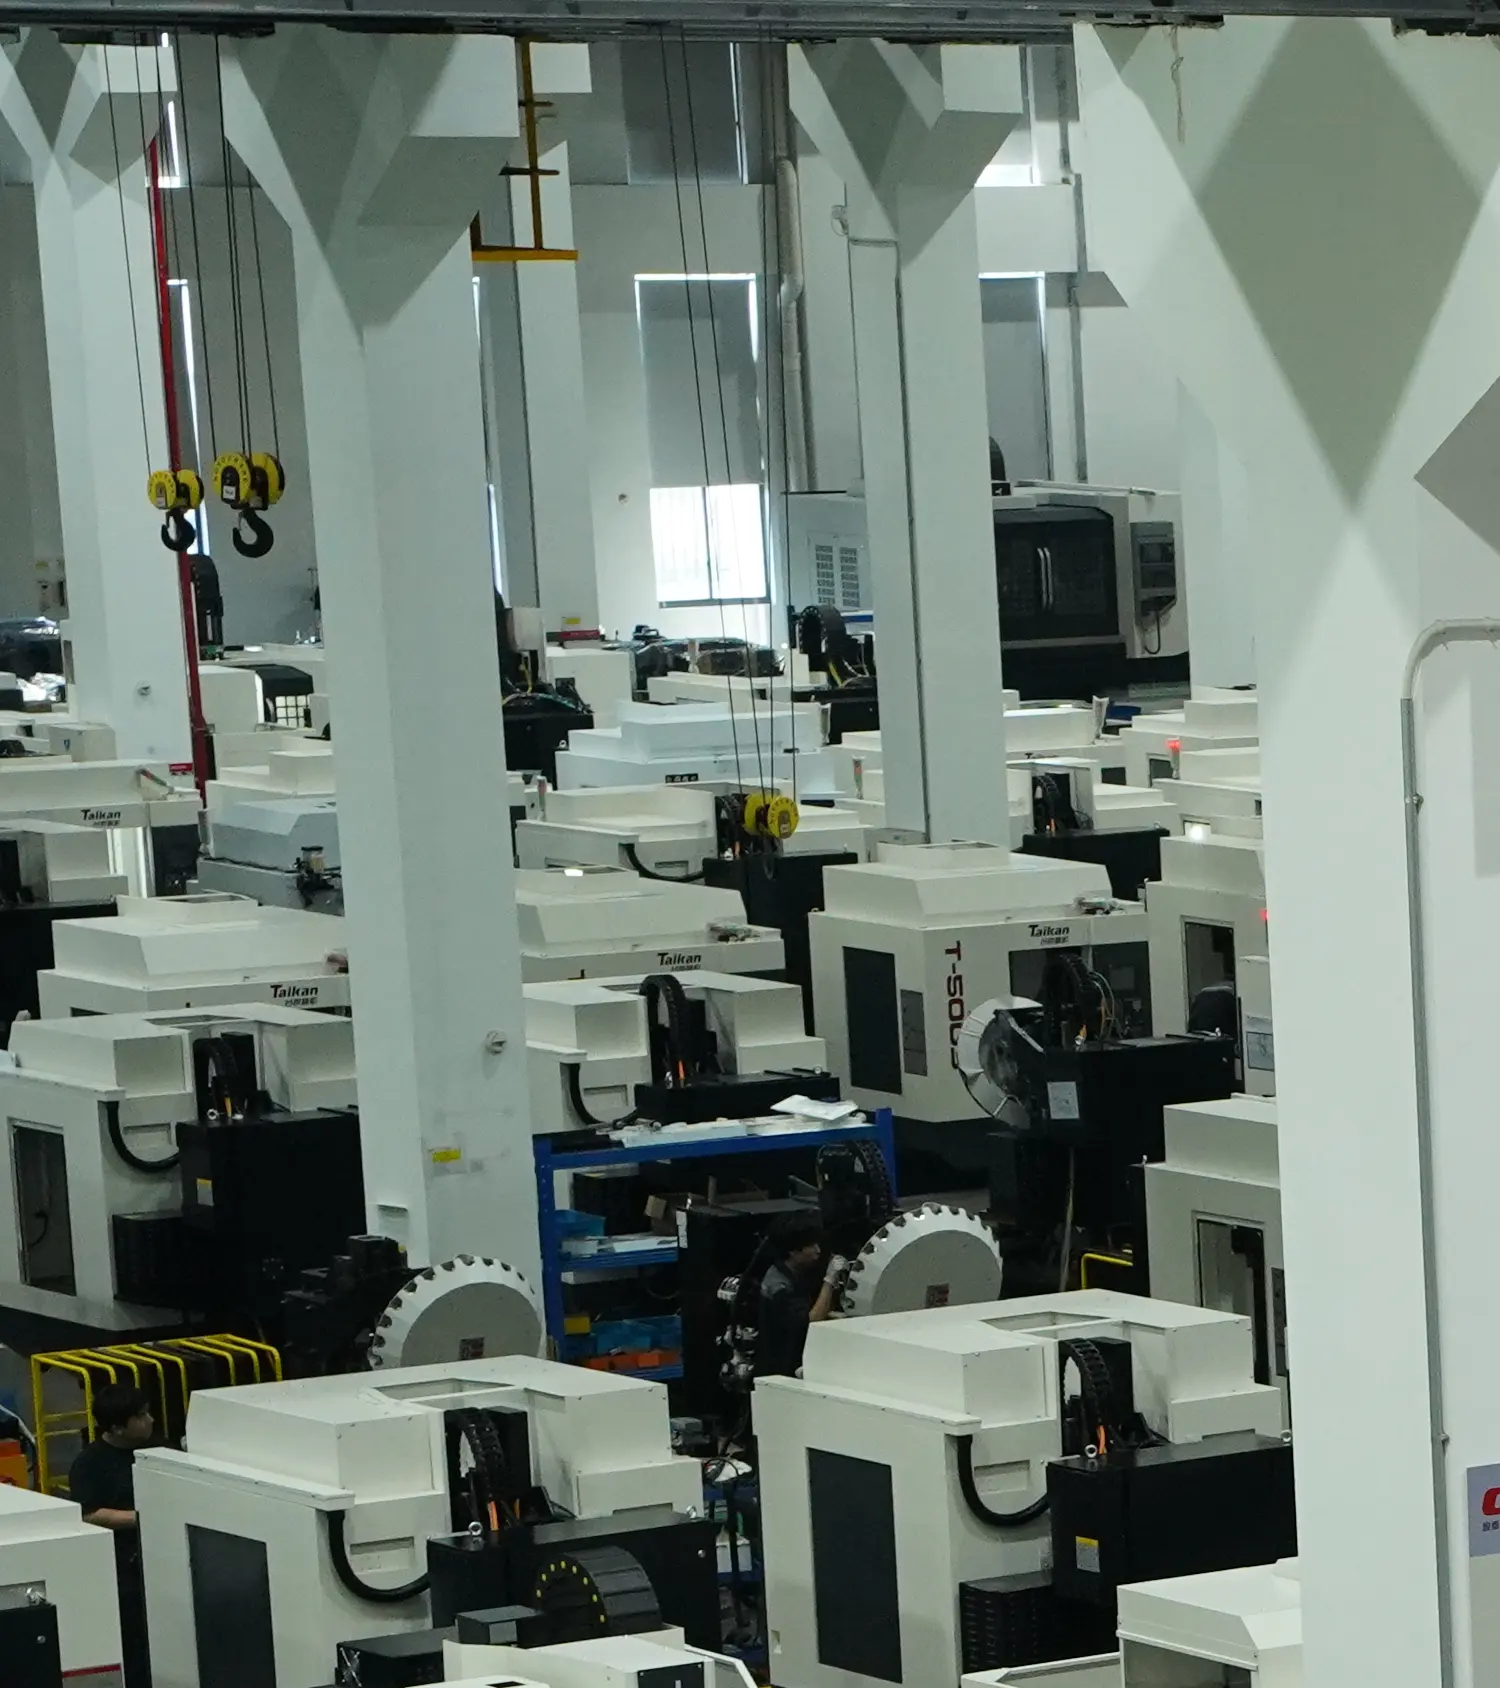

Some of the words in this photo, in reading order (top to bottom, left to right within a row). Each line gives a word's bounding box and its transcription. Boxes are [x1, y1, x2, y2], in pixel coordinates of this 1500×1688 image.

[1028, 924, 1070, 938] Taikan
[657, 952, 702, 967] Taikan
[270, 984, 320, 999] Taikan
